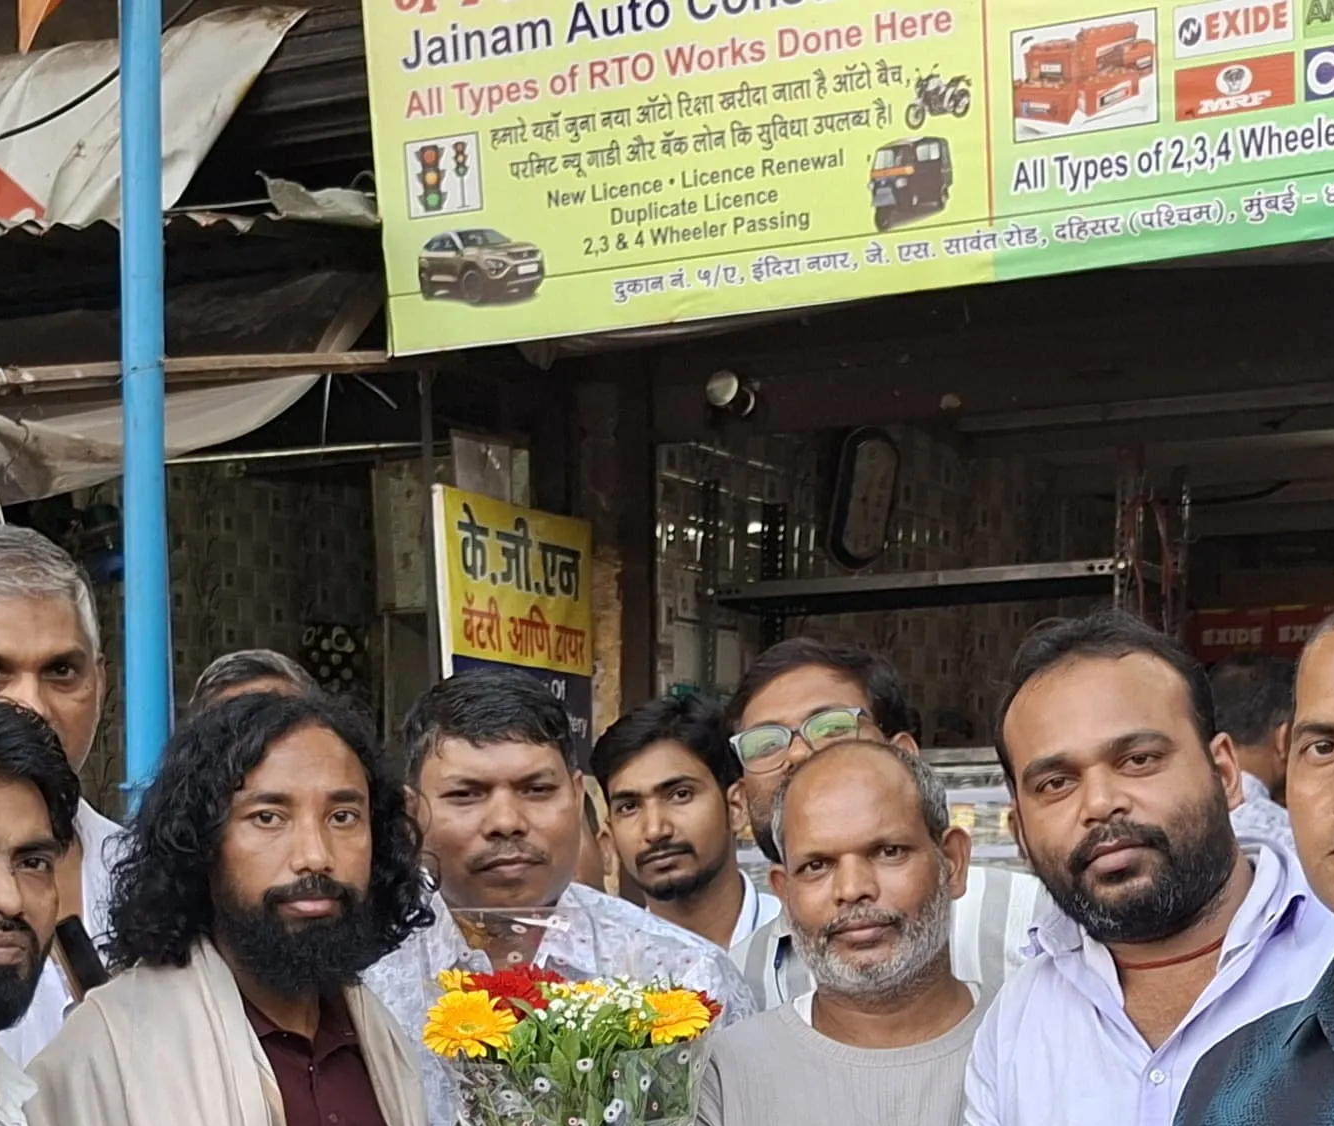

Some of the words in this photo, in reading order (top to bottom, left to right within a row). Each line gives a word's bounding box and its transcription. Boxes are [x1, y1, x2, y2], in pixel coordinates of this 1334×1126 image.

[402, 18, 552, 69] Jainam
[567, 0, 670, 43] Auto
[1205, 3, 1288, 41] EXIDE
[405, 86, 442, 118] All
[452, 78, 540, 117] Types
[549, 63, 580, 96] of
[589, 52, 655, 90] RTO
[664, 37, 766, 77] Works
[777, 24, 863, 58] Done
[874, 10, 953, 43] Here
[490, 116, 528, 150] हमारे
[601, 107, 631, 130] नया
[637, 94, 674, 124] ऑटो
[677, 91, 715, 118] रिक्षा
[718, 81, 767, 115] खरीदा
[771, 79, 811, 103] जाता
[816, 68, 828, 100] है
[832, 62, 871, 94] ऑटो
[1198, 90, 1272, 115] MRF
[509, 152, 559, 180] परमिट
[626, 135, 656, 162] और
[693, 125, 727, 154] लोन
[731, 120, 753, 150] कि
[757, 114, 809, 151] सुविधा
[1013, 158, 1045, 191] All
[1054, 154, 1128, 191] Types
[1137, 143, 1164, 173] of
[1170, 132, 1231, 172] 2,3,4
[547, 188, 586, 209] New
[591, 178, 664, 202] Licence
[681, 164, 756, 189] Licence
[761, 148, 844, 178] Renewal
[610, 197, 698, 228] Duplicate
[704, 187, 779, 212] Licence
[583, 236, 609, 257] 2,3
[615, 233, 629, 252] &
[634, 230, 645, 249] 4
[650, 220, 727, 247] Wheeler
[733, 209, 810, 235] Passing
[614, 273, 665, 302] दुकान
[751, 253, 801, 281] इंदिरा
[806, 251, 858, 273] नगर,
[944, 229, 998, 255] सावंत
[1004, 224, 1048, 247] रोड,
[1055, 216, 1121, 241] दहिसर
[1244, 184, 1296, 221] मुंबई
[507, 604, 552, 660] आणि
[555, 623, 587, 666] टायर
[1202, 627, 1263, 645] EXIDE
